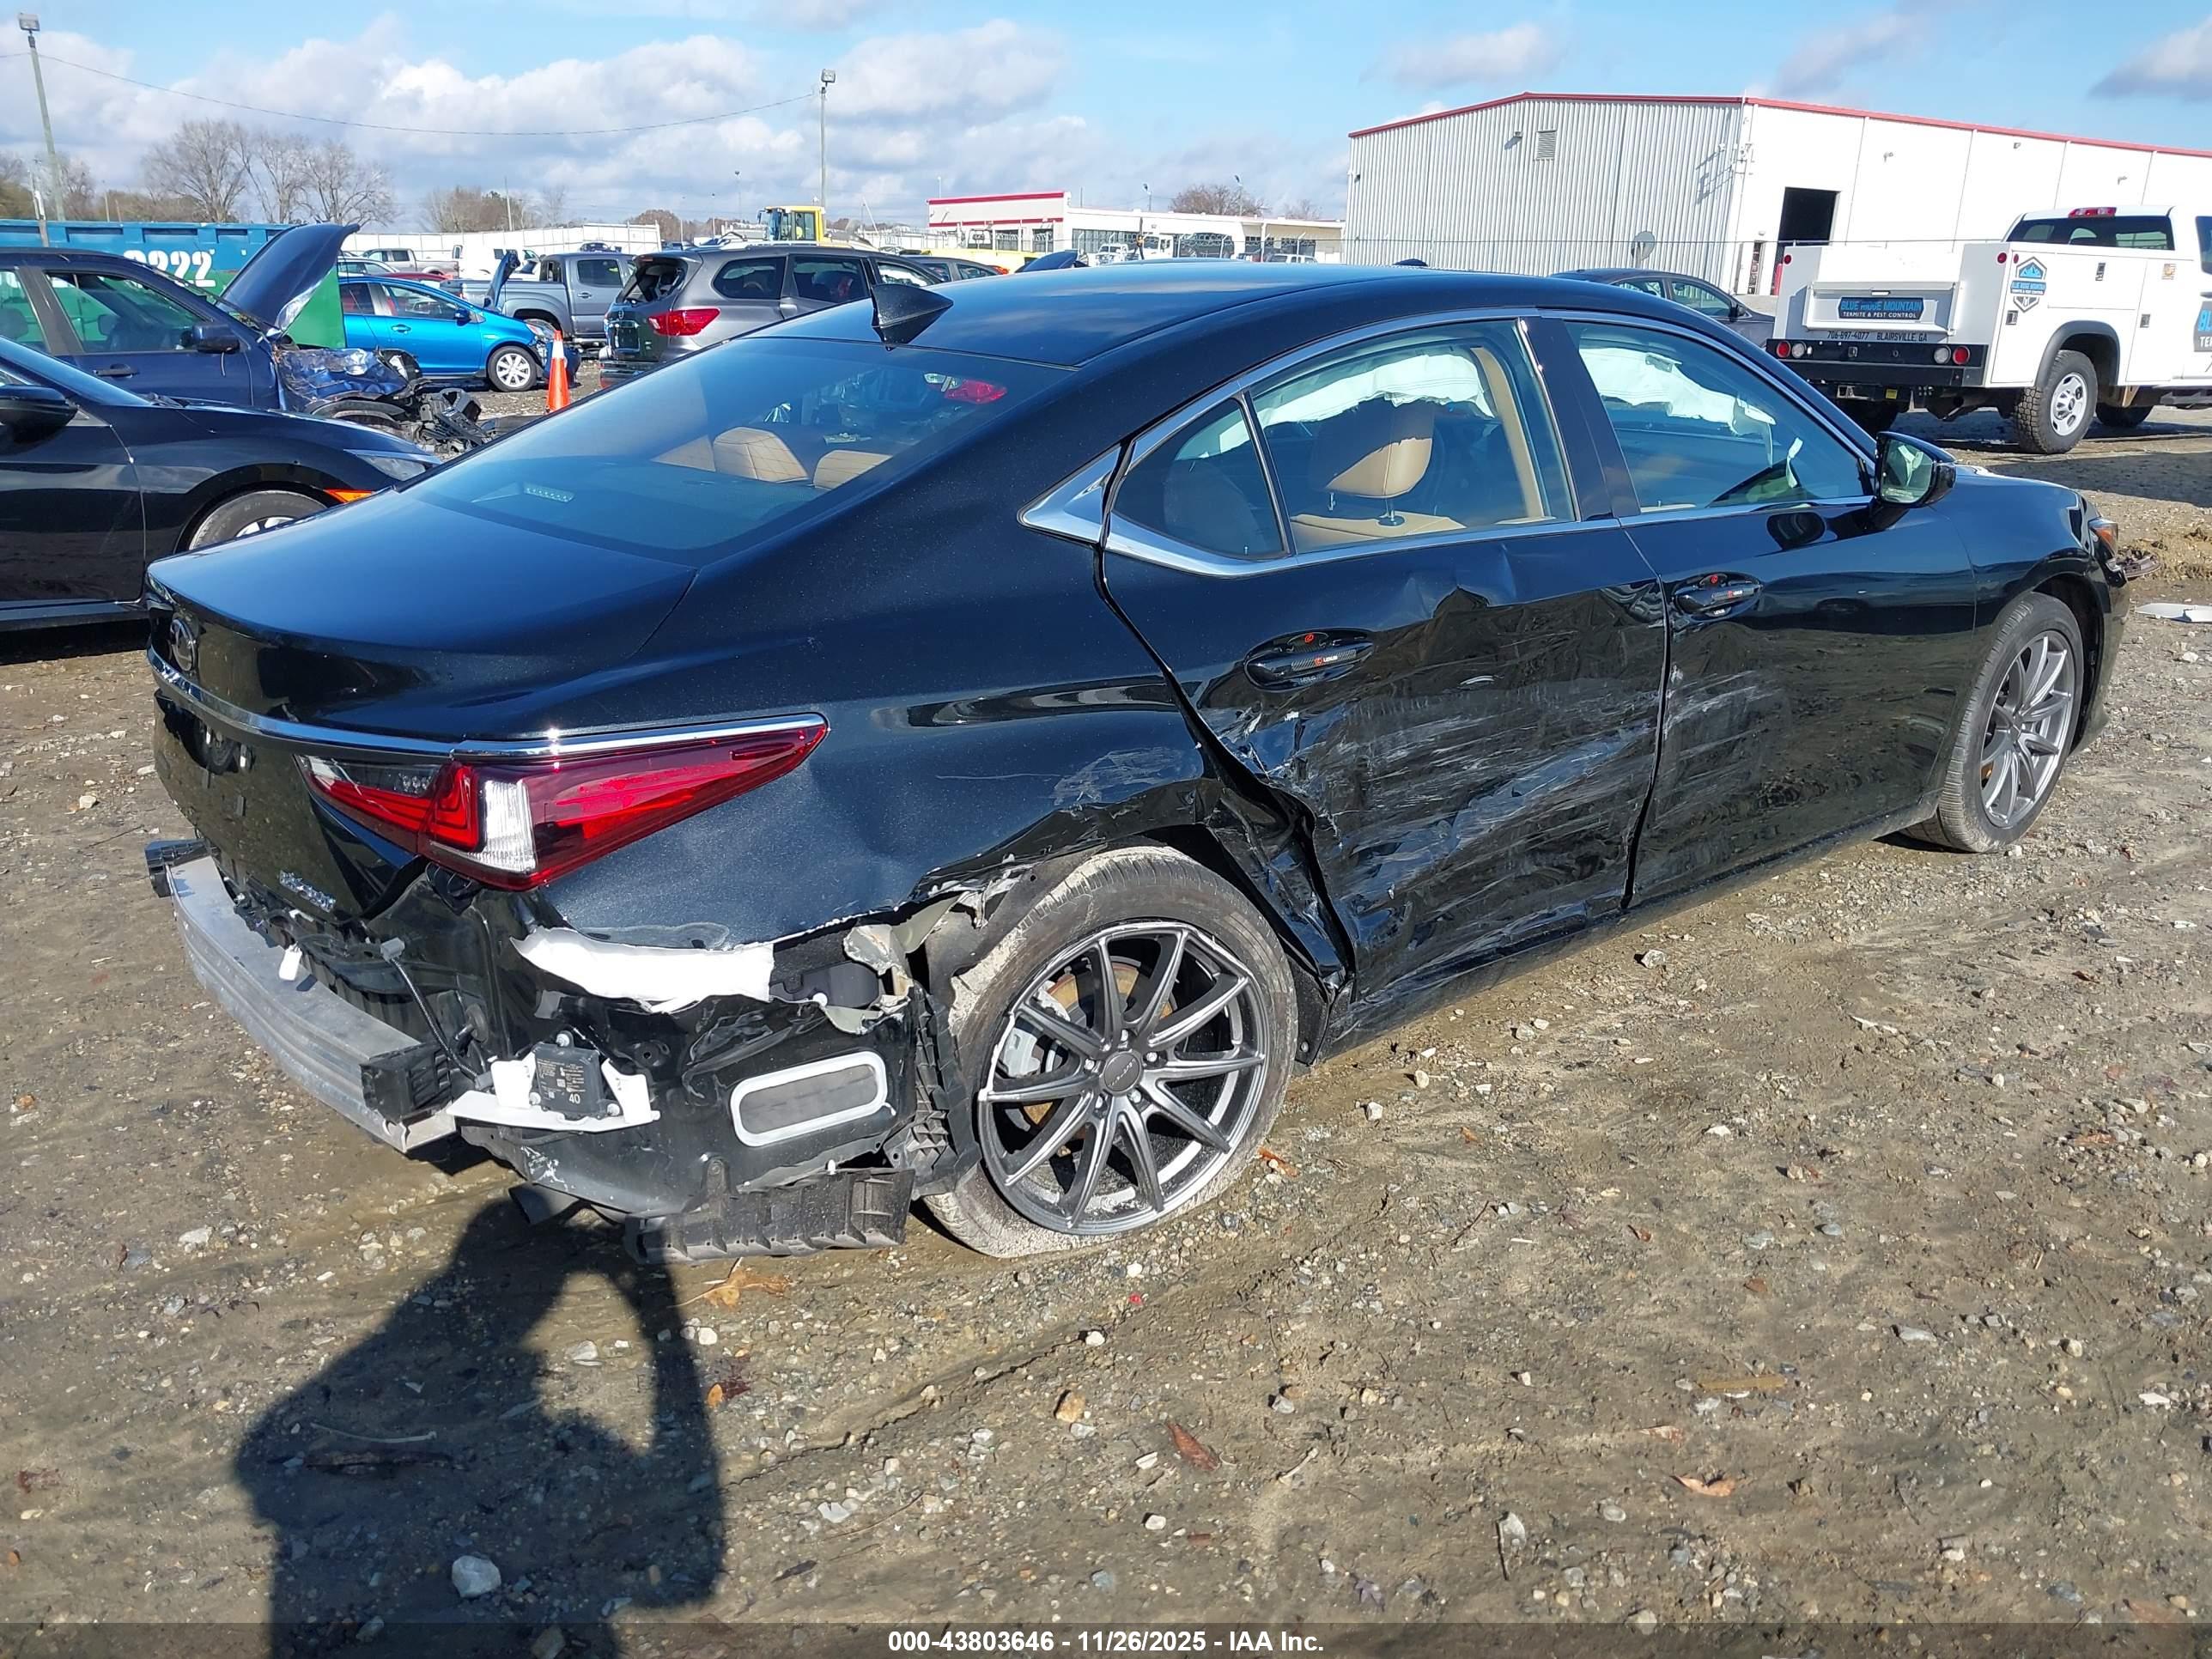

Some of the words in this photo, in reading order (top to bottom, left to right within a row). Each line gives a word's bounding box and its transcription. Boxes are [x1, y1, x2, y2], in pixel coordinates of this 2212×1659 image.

[1840, 301, 1859, 310] BLUE
[1882, 301, 1923, 311] MOUNTAIN
[1918, 332, 1928, 342] GA
[568, 1093, 580, 1104] 40
